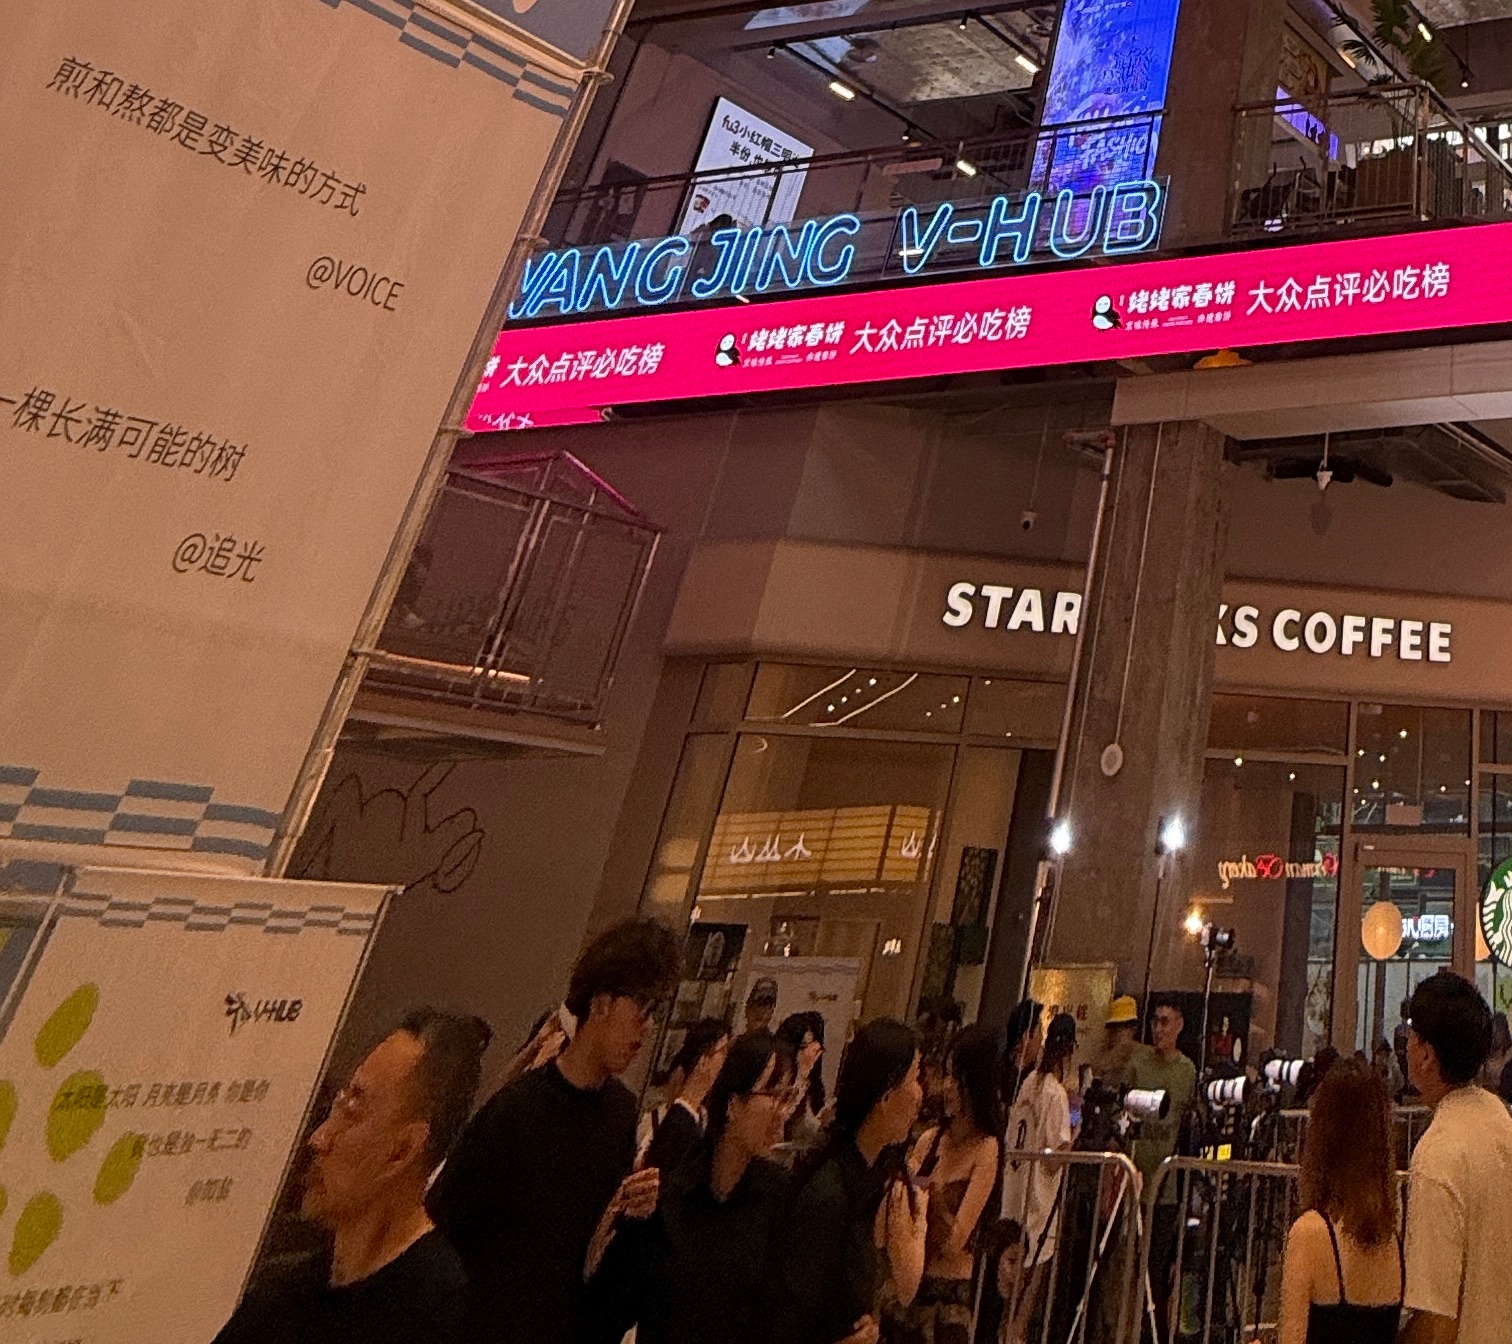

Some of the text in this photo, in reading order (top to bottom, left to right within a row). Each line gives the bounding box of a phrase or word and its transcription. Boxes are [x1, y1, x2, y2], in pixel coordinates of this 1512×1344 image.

[46, 53, 369, 219] 煎和熬都是变美味的方式
[899, 178, 1162, 275] V-HUB
[305, 254, 407, 313] @VOICE
[1126, 261, 1450, 316] 姥姥家春饼 大众点评必吃榜
[853, 305, 1034, 360] 大众点评必吃榜
[500, 342, 665, 389] 大众点评必吃榜
[171, 532, 267, 585] @追光
[942, 580, 1453, 664] STARKS COFFEE
